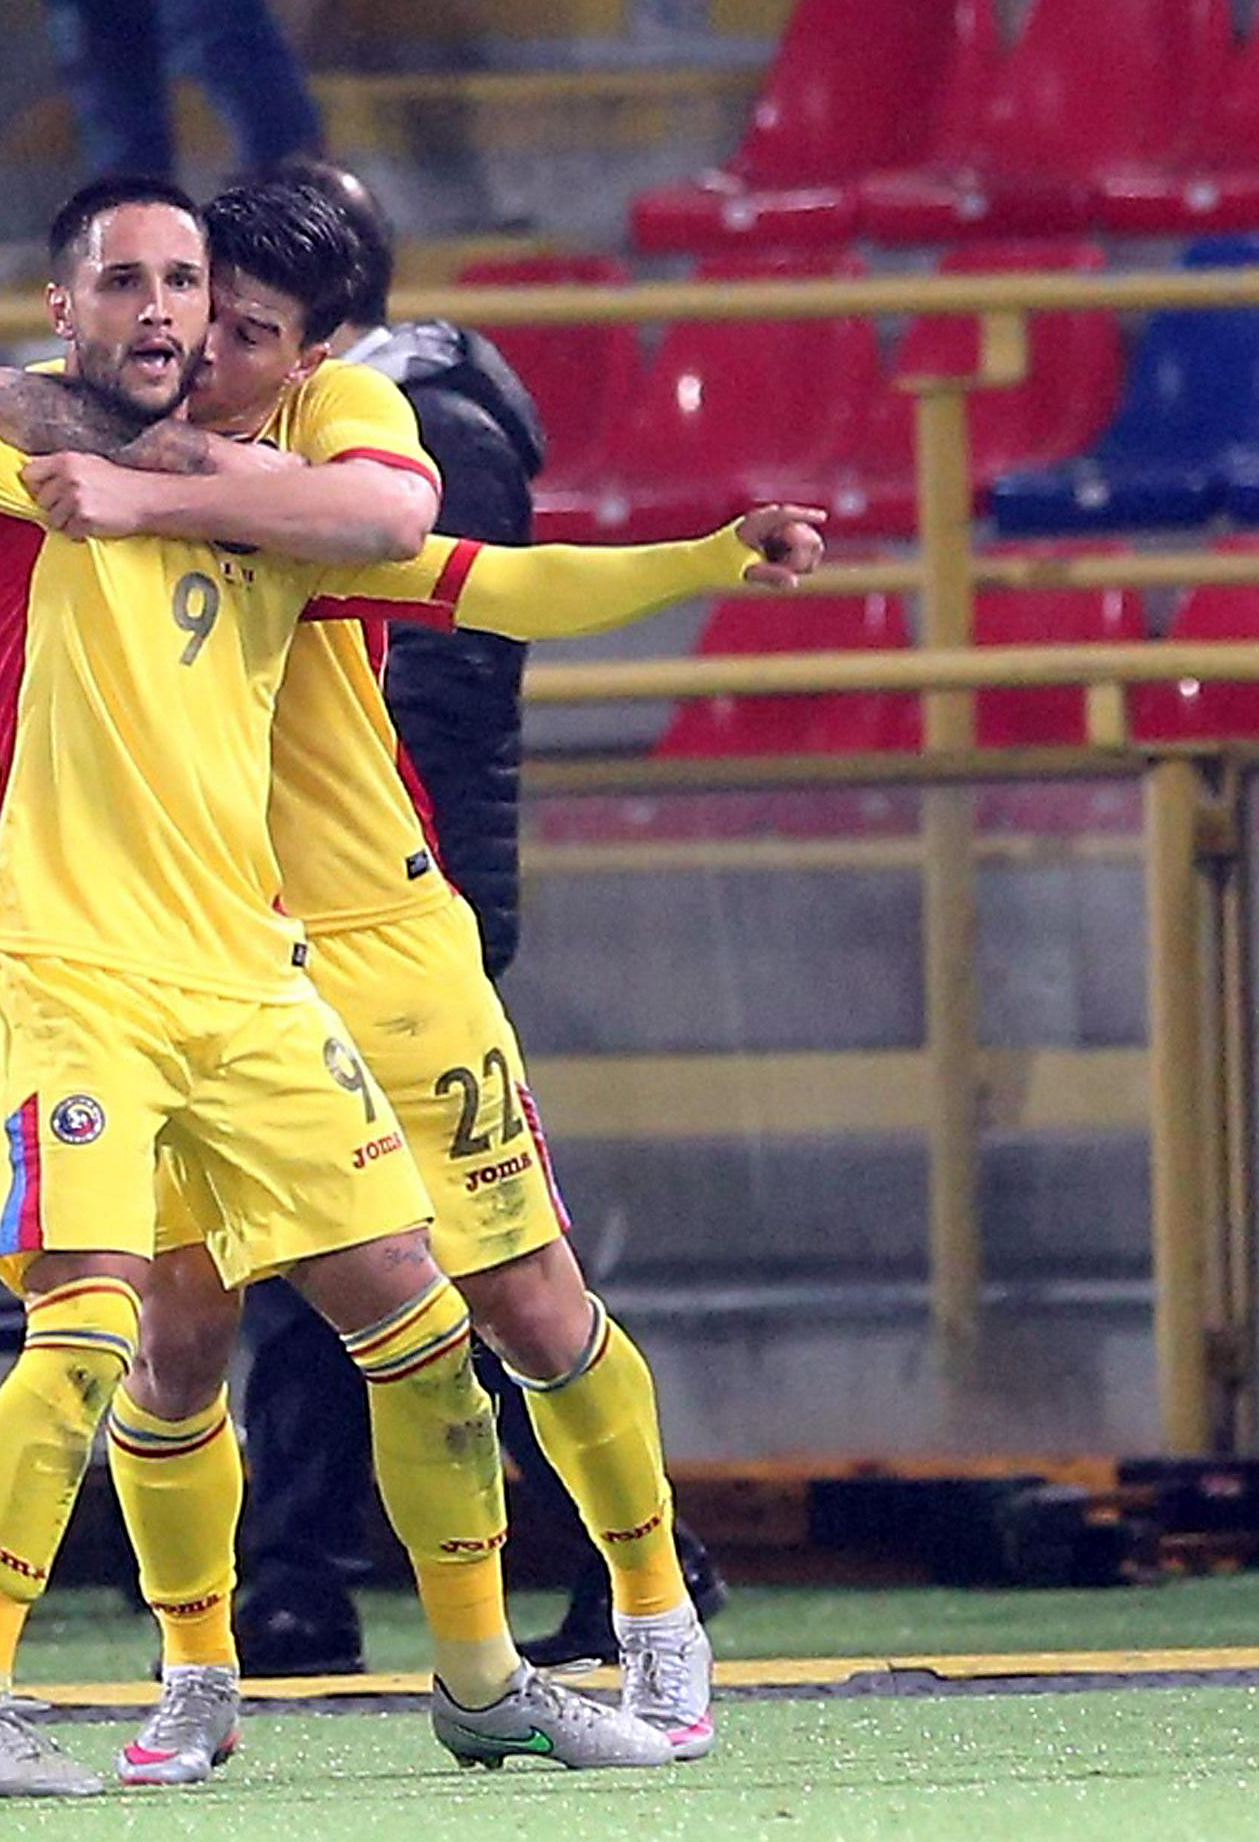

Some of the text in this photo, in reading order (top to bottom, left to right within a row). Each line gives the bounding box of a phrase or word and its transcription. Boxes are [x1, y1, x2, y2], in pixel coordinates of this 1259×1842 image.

[172, 571, 221, 666] 9
[323, 1036, 377, 1125] 9
[434, 1047, 524, 1160] 22
